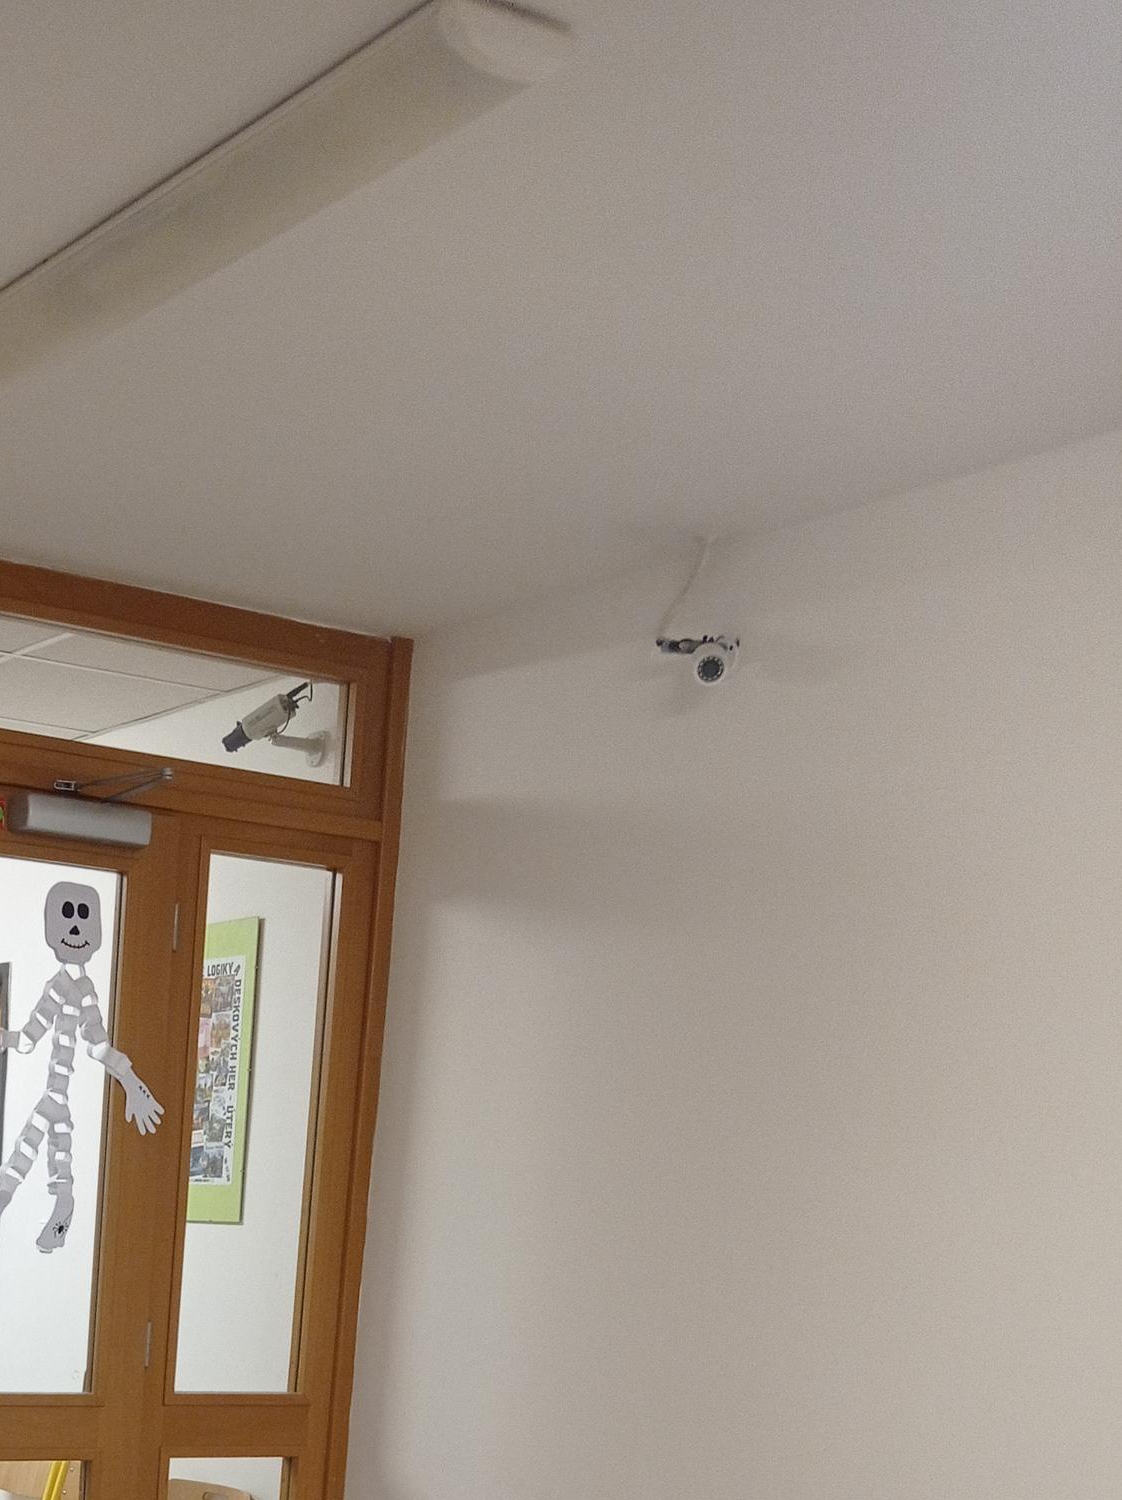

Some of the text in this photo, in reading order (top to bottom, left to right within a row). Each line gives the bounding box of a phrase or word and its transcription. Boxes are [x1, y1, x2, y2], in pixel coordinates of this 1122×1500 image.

[207, 961, 234, 977] LOGIKY
[229, 979, 242, 1061] DESKOVÝCH
[227, 1065, 237, 1091] HER
[224, 1105, 236, 1149] ÚTERÝ
